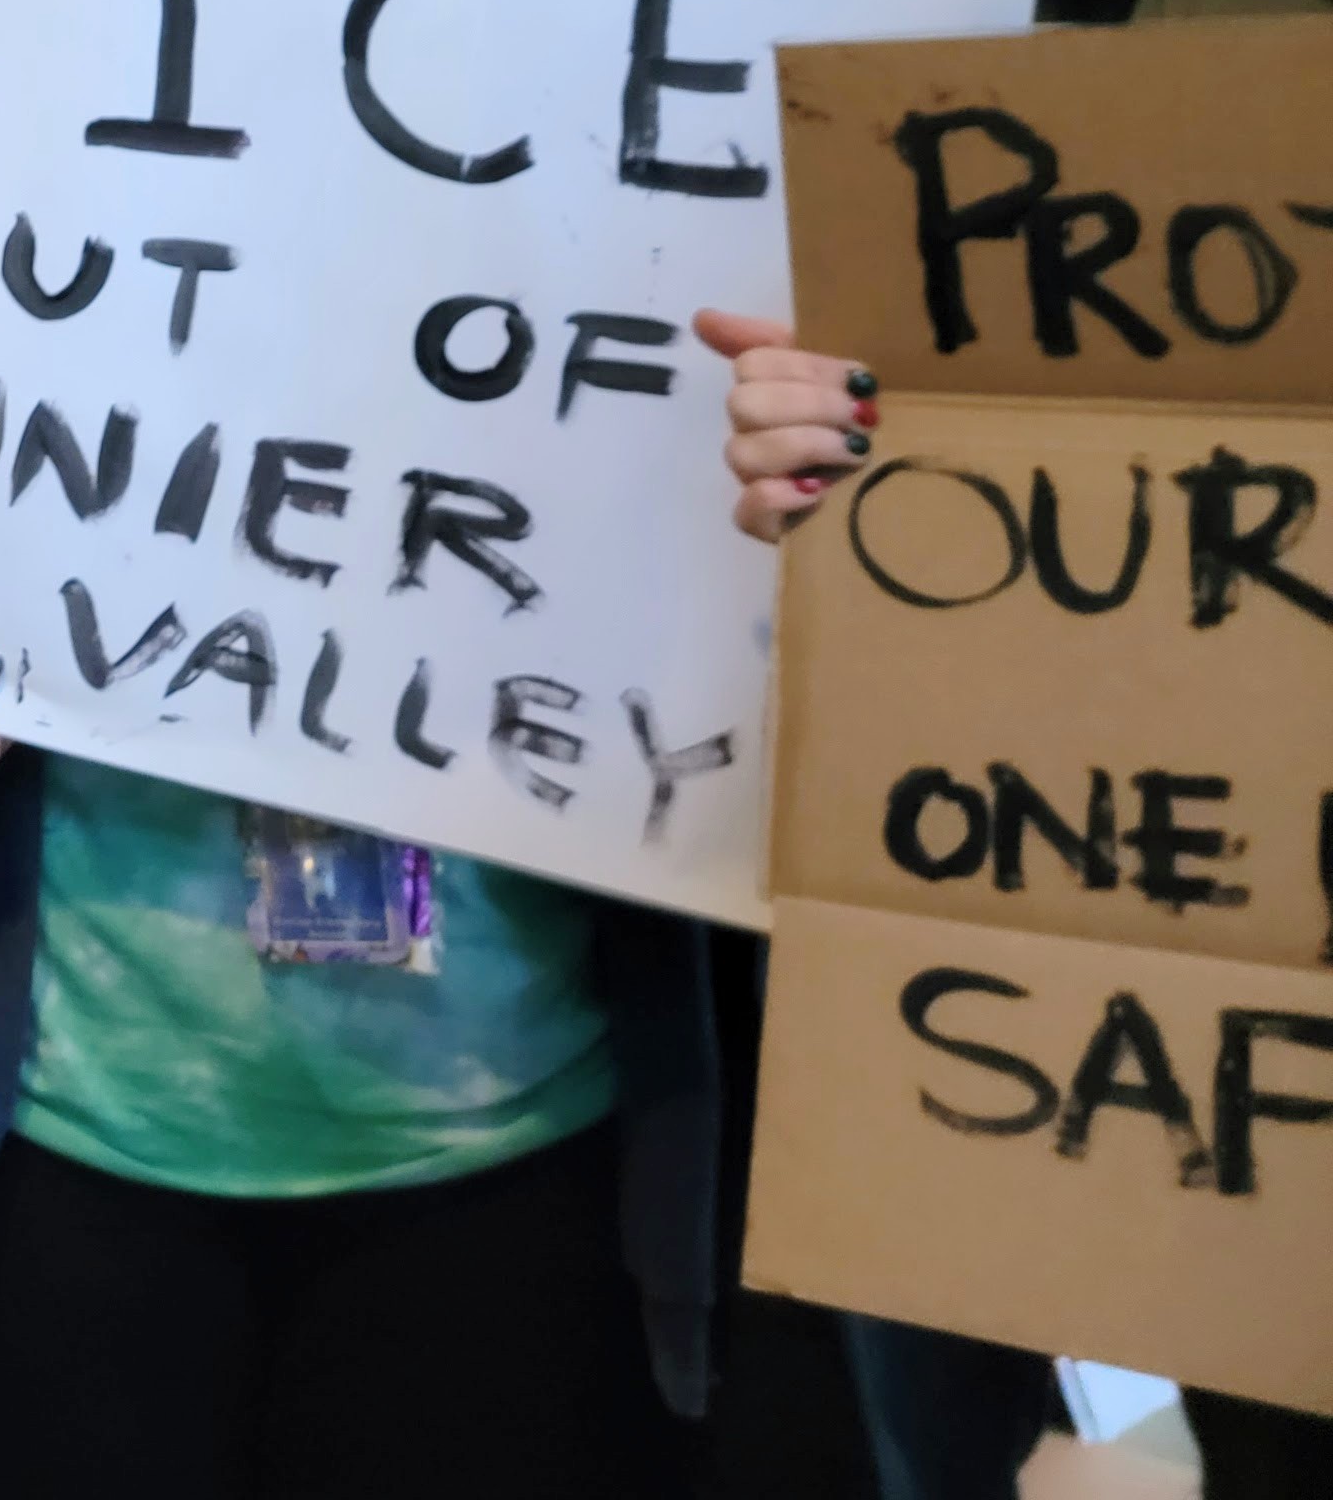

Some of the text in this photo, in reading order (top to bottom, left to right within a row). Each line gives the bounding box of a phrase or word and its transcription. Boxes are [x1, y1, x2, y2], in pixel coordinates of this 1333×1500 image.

[413, 294, 683, 423] OF
[848, 442, 1333, 630] OUR
[59, 576, 739, 848] VALLEY
[883, 760, 1251, 914] ONE
[898, 964, 1333, 1198] SAF
